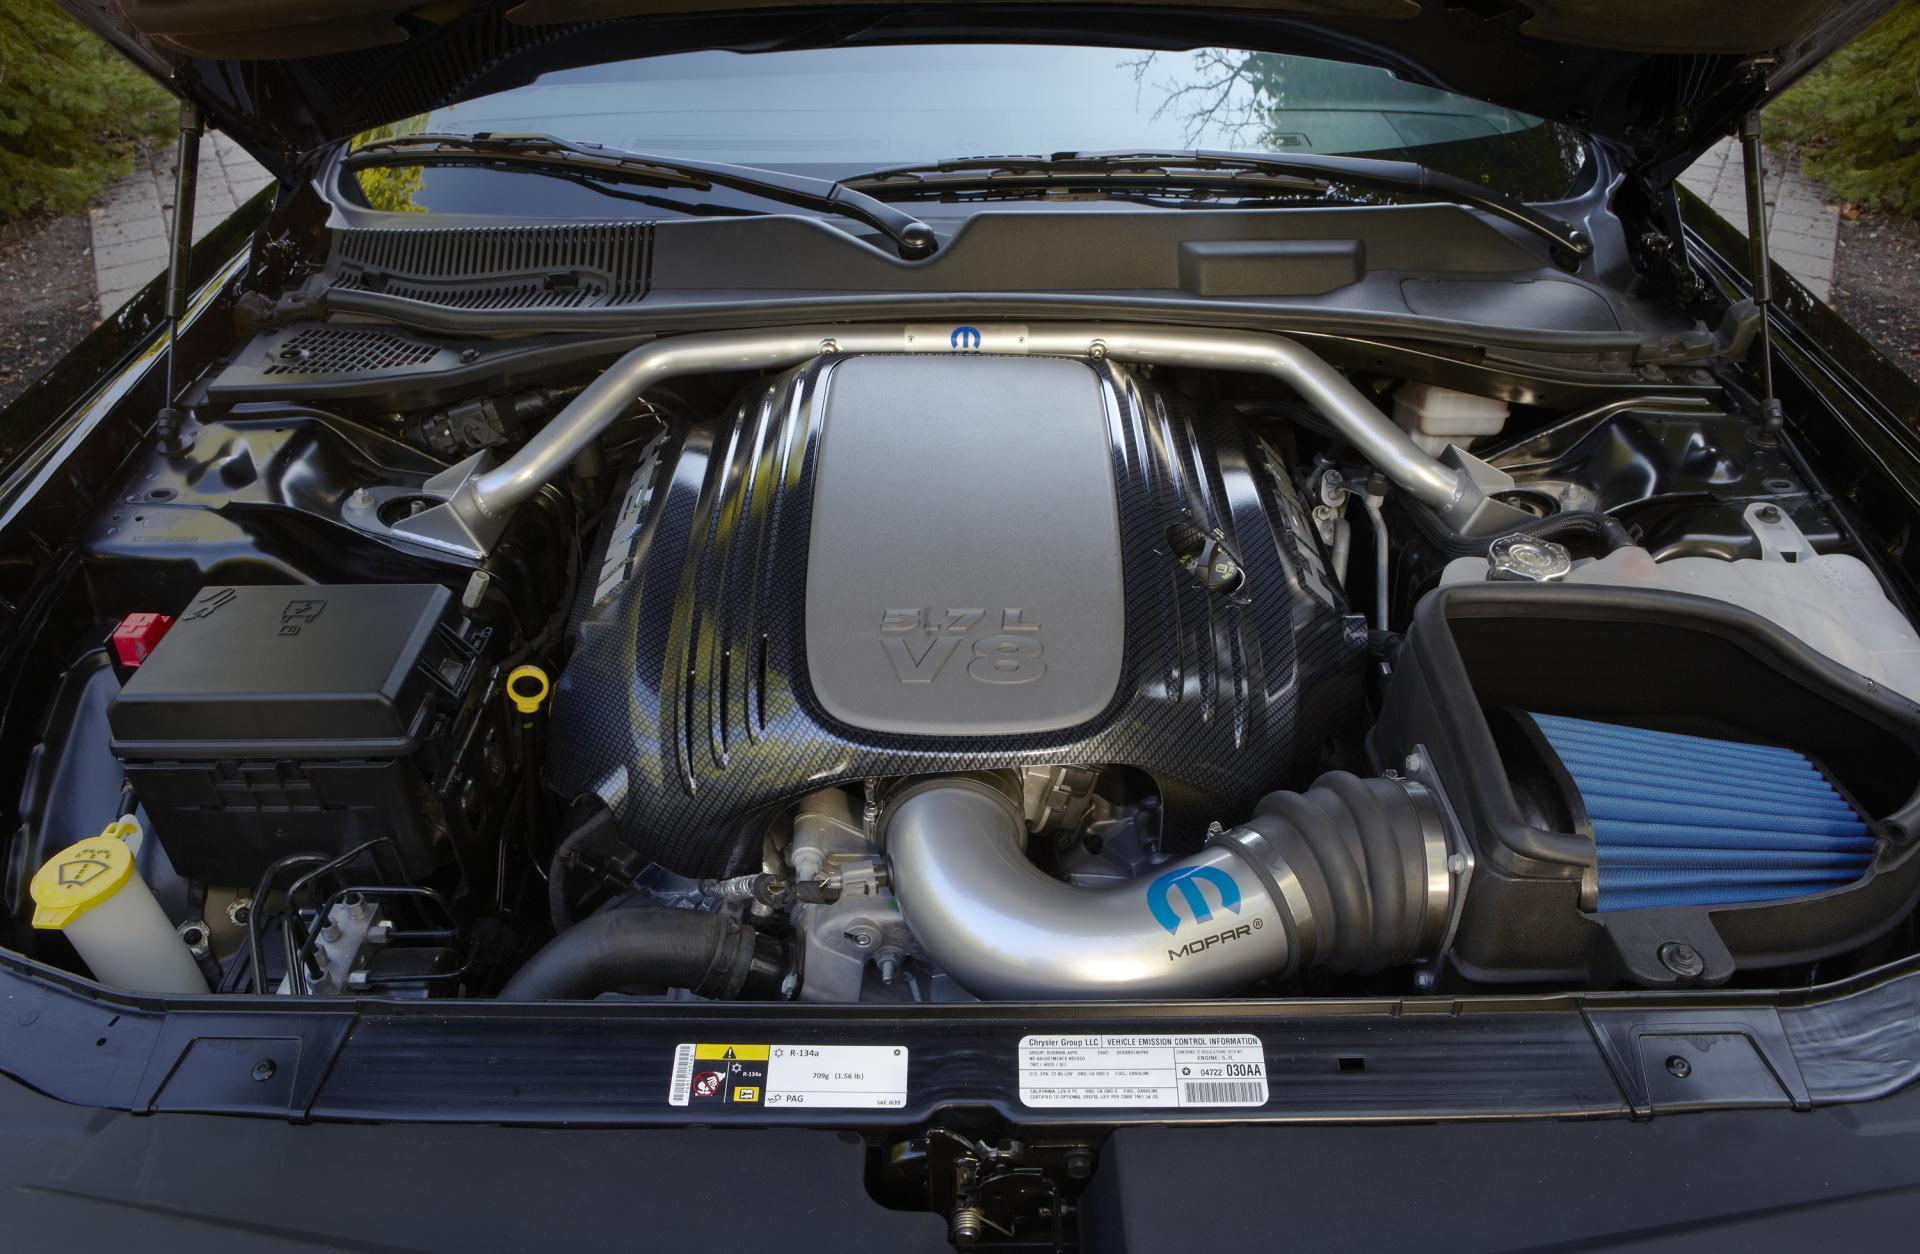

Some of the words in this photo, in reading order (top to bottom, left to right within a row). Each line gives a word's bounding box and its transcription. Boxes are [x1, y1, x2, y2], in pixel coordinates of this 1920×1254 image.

[879, 634, 1048, 685] V8
[1029, 1038, 1058, 1048] Chrysler
[1061, 1038, 1083, 1048] Group
[1085, 1038, 1099, 1046] LLC
[1107, 1038, 1136, 1046] VEHICLE
[1138, 1038, 1172, 1046] EMISSION
[1174, 1037, 1207, 1046] CONTROL
[1209, 1037, 1258, 1045] INFORMATION
[790, 1049, 819, 1057] R-134a
[1200, 1068, 1223, 1077] 04722
[1226, 1064, 1262, 1077] 030AA
[812, 1072, 830, 1081] 709g
[786, 1094, 804, 1103] PAG
